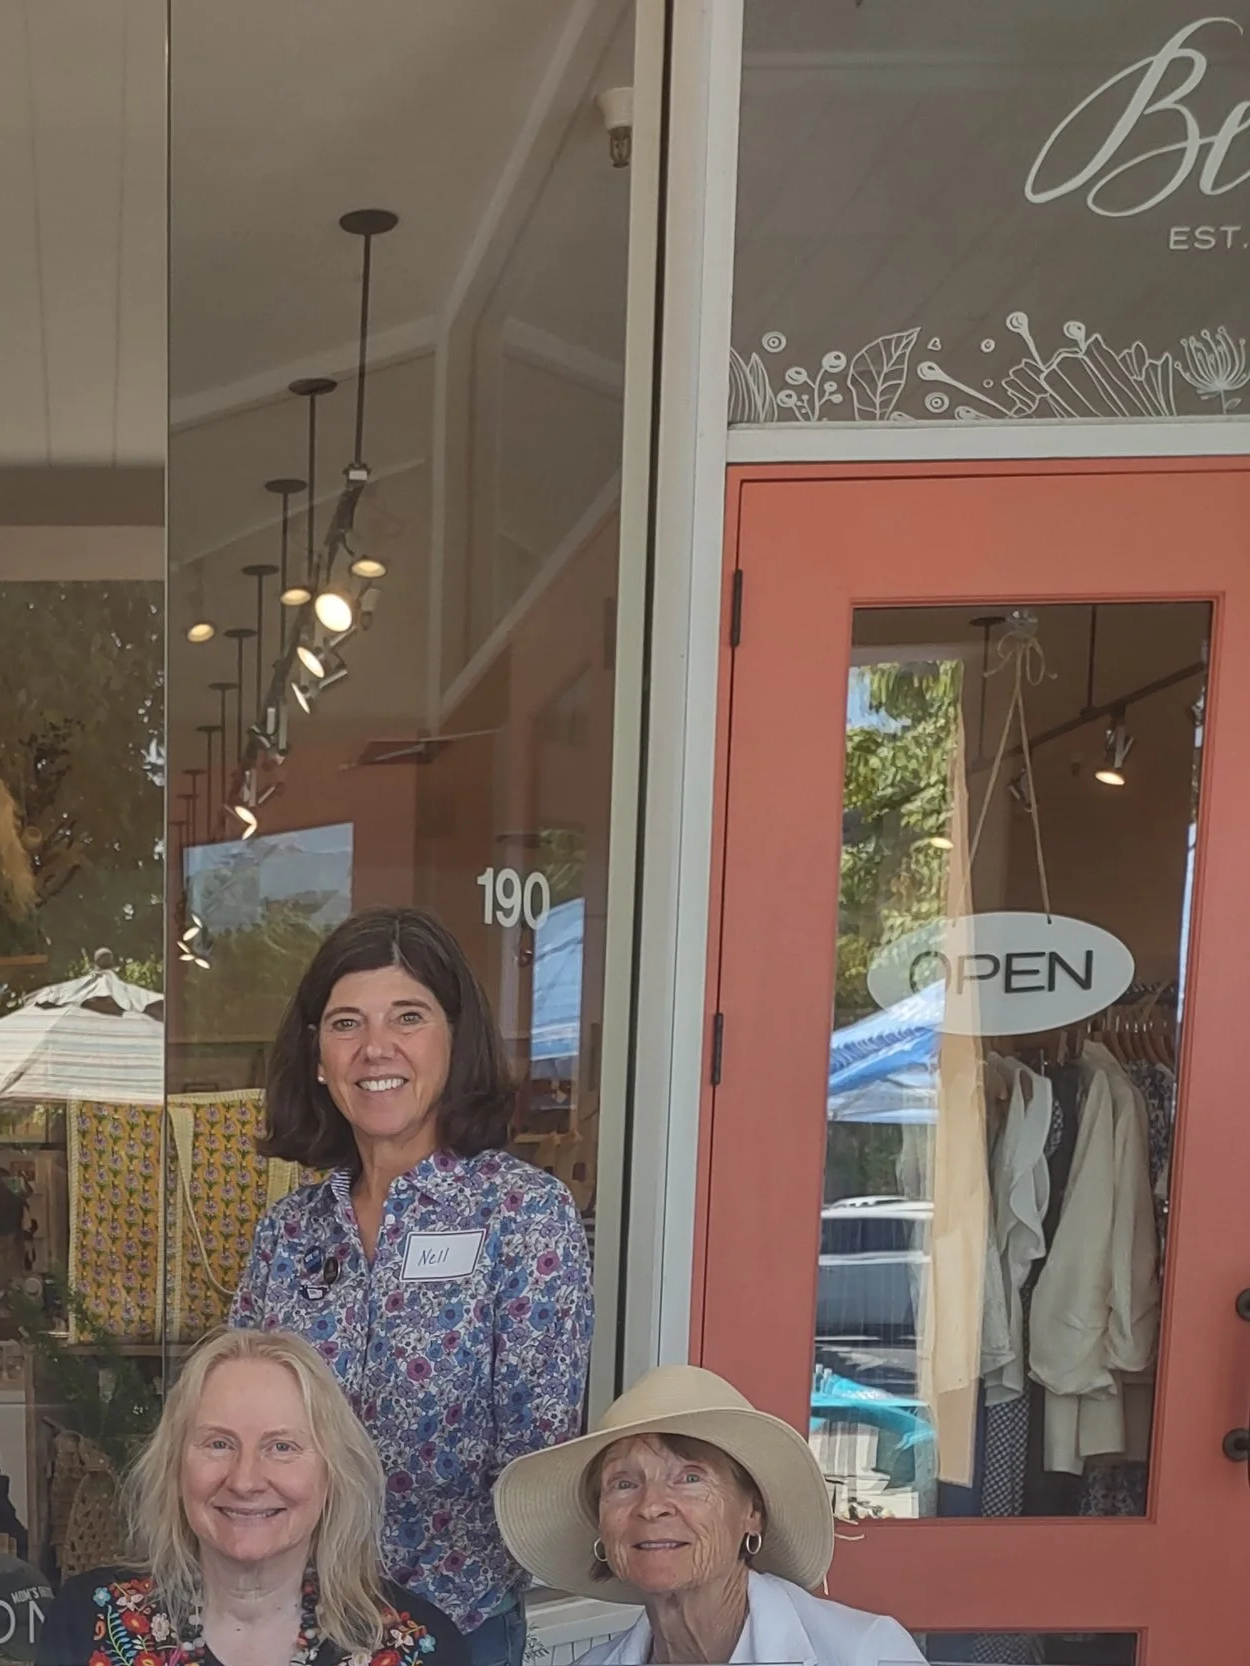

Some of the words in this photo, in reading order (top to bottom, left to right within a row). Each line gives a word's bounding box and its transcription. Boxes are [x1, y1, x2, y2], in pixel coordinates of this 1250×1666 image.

[1169, 226, 1249, 250] EST.
[477, 868, 550, 931] 190
[910, 949, 1093, 996] OPEN
[418, 1247, 450, 1266] Nell
